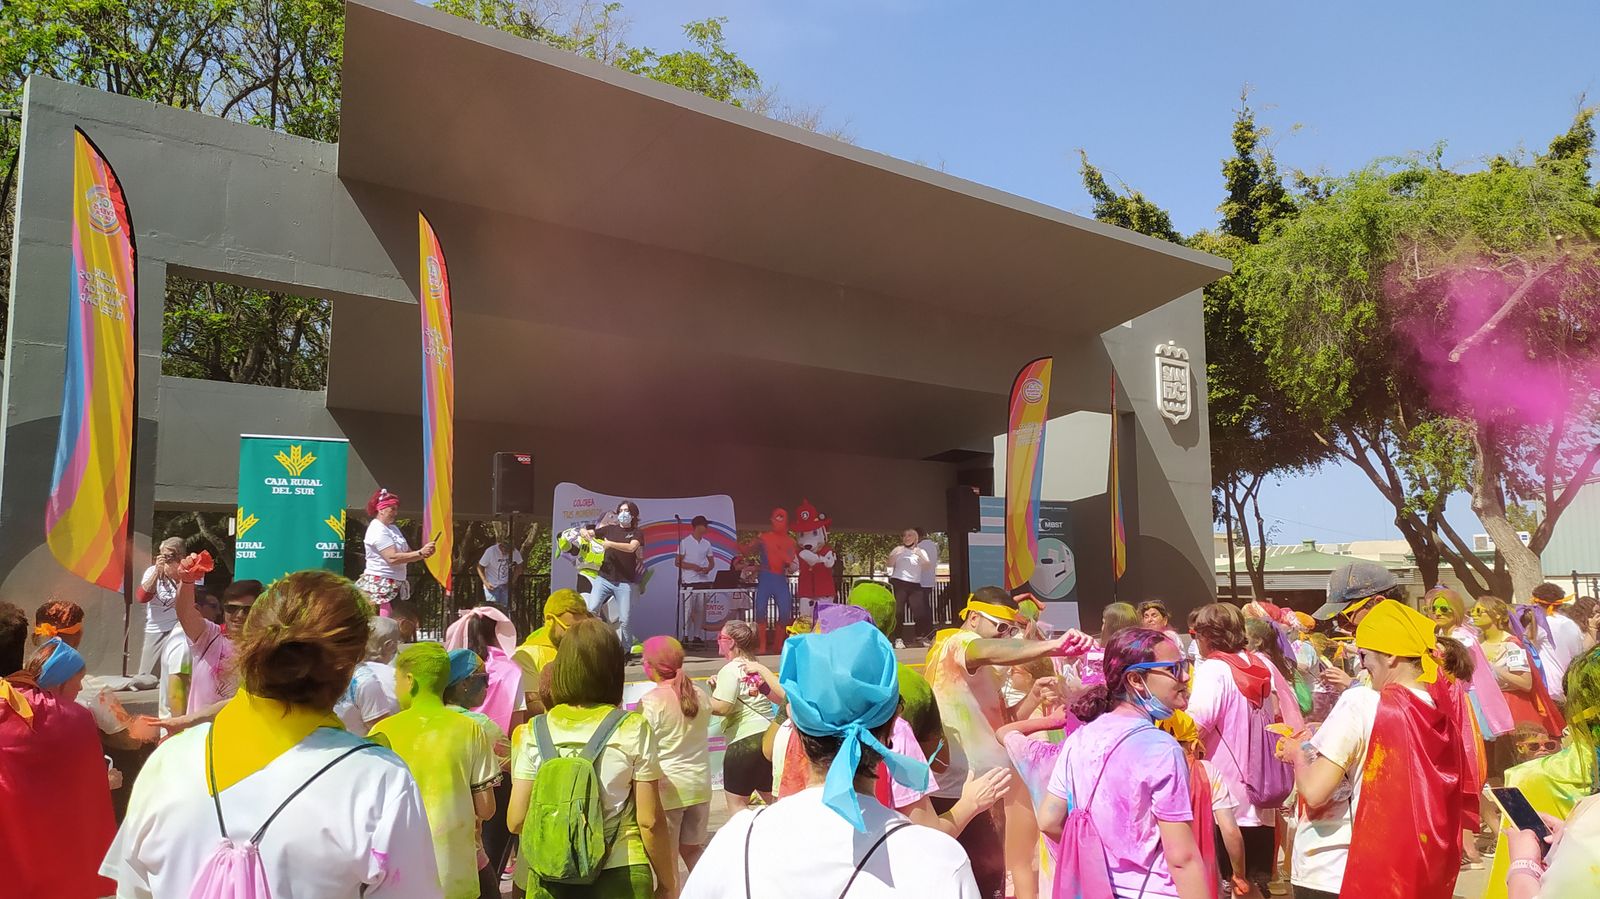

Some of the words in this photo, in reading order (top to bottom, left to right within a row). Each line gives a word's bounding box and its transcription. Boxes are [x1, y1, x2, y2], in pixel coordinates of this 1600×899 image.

[1162, 365, 1187, 385] SAN
[264, 477, 288, 486] CAJA
[290, 478, 323, 487] RURAL
[272, 487, 292, 495] DEL
[294, 487, 315, 495] SUR
[315, 542, 339, 550] CAJA
[235, 551, 257, 559] SUR
[322, 551, 343, 559] DEL
